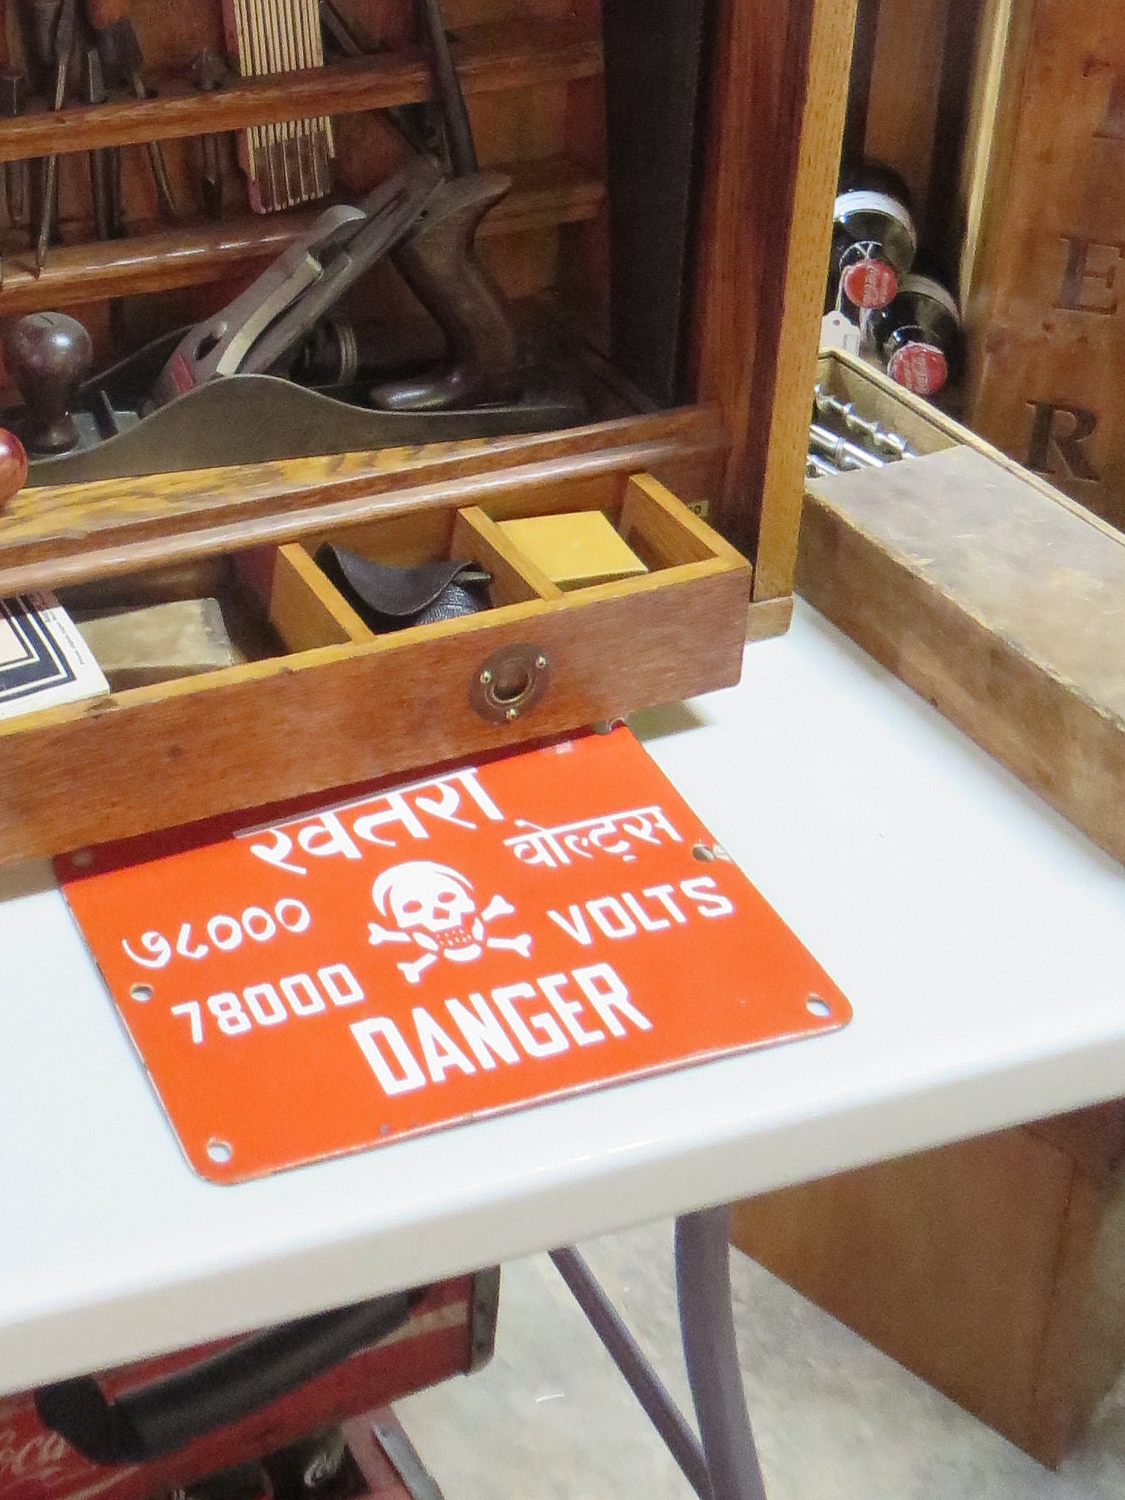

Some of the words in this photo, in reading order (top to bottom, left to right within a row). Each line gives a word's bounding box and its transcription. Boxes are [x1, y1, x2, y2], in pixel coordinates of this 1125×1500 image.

[237, 767, 505, 875] खतरा
[546, 874, 736, 948] VOLTS
[170, 962, 366, 1045] 78000
[348, 961, 654, 1098] DANGER
